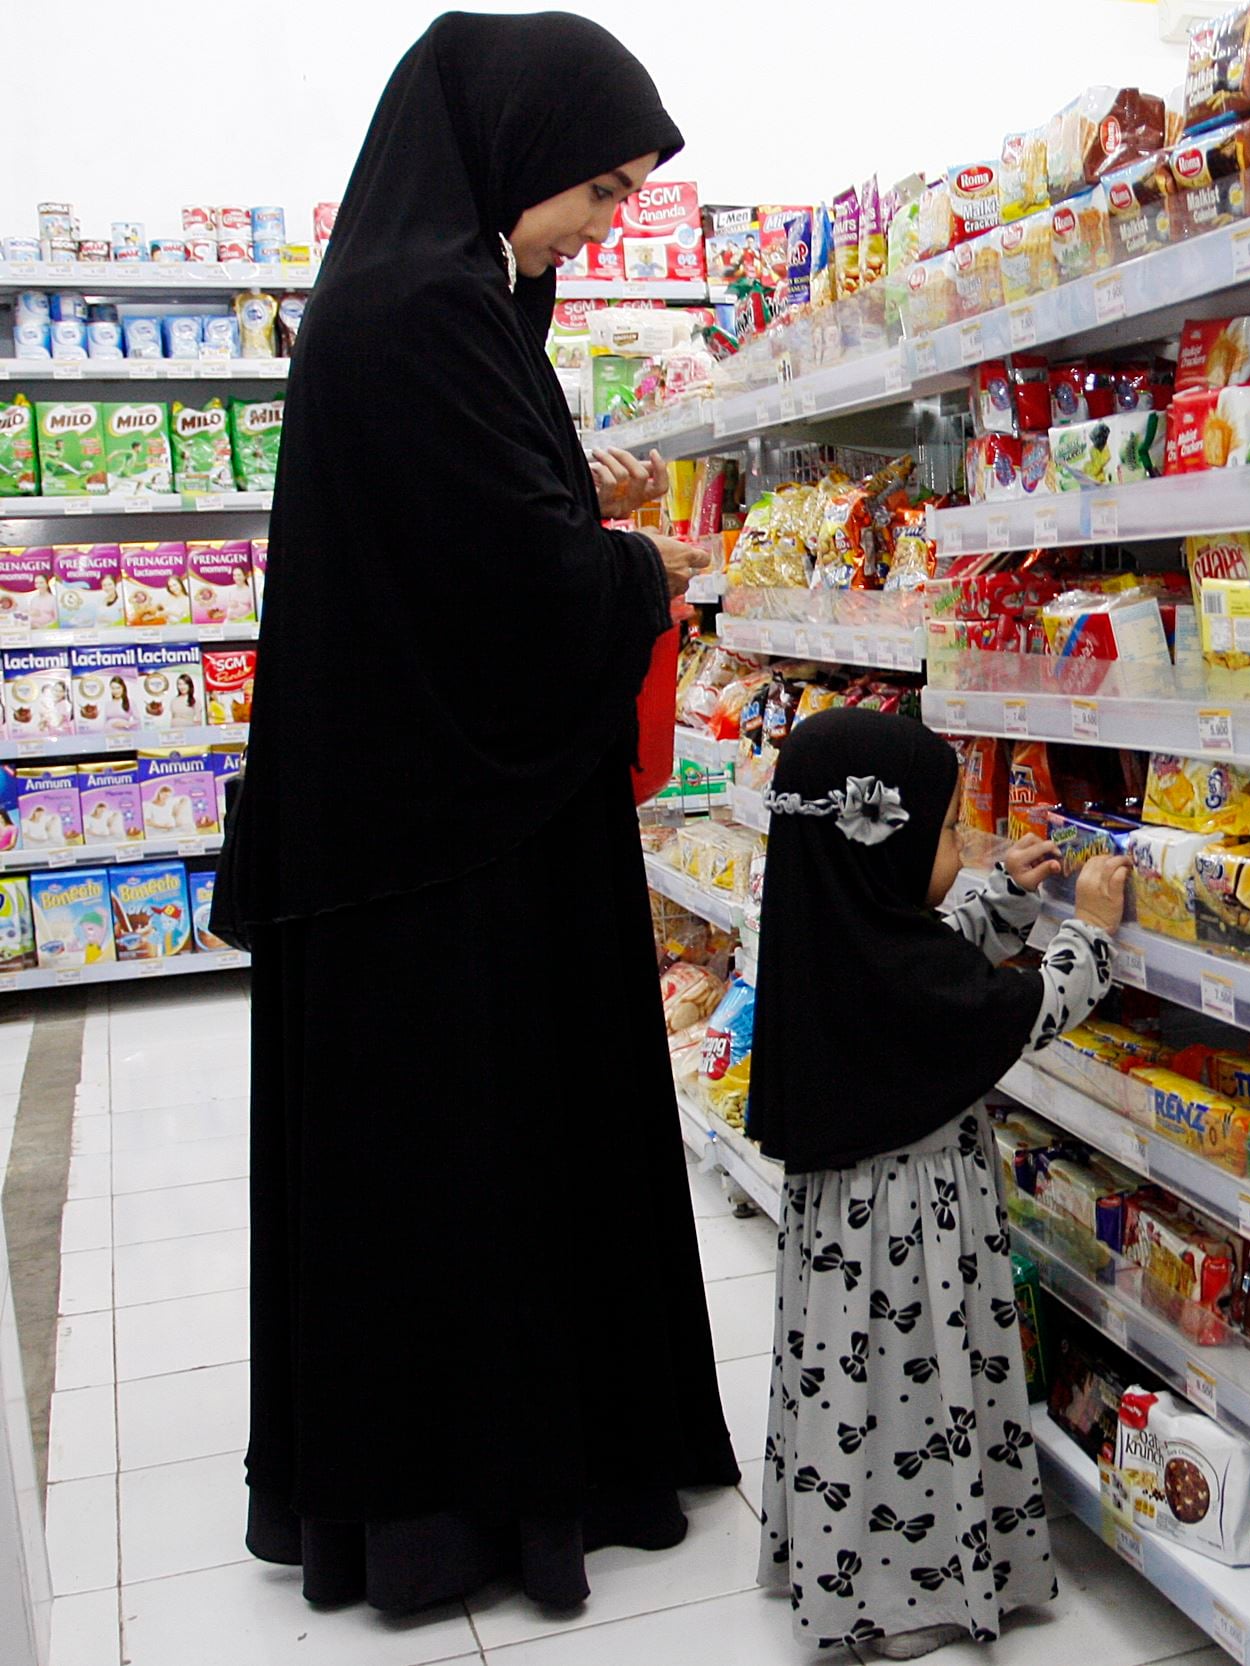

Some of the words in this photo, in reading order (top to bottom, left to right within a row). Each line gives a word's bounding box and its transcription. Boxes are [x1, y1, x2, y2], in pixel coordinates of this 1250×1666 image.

[961, 172, 991, 188] Roma
[638, 187, 682, 206] SGM
[638, 203, 686, 224] Ananda
[716, 208, 750, 229] L-Men
[50, 413, 92, 430] MILO
[116, 413, 158, 430] MILO
[180, 413, 222, 430] MILO
[249, 409, 284, 426] MIL
[0, 560, 50, 571] RENAGEN
[59, 557, 117, 571] PRENAGEN
[126, 555, 183, 567] PRENAGEN
[192, 553, 247, 565] PRENAGEN
[4, 654, 69, 670] Lactamil
[71, 649, 135, 667] Lactamil
[137, 646, 199, 665] Lactamil
[216, 655, 247, 673] SGM
[148, 756, 205, 775] Anmum
[24, 778, 72, 791] Anmum
[86, 773, 133, 787] Anmum
[39, 880, 105, 910] Boneeto
[119, 874, 182, 903] Boneeto
[1147, 1086, 1209, 1133] TRENZ
